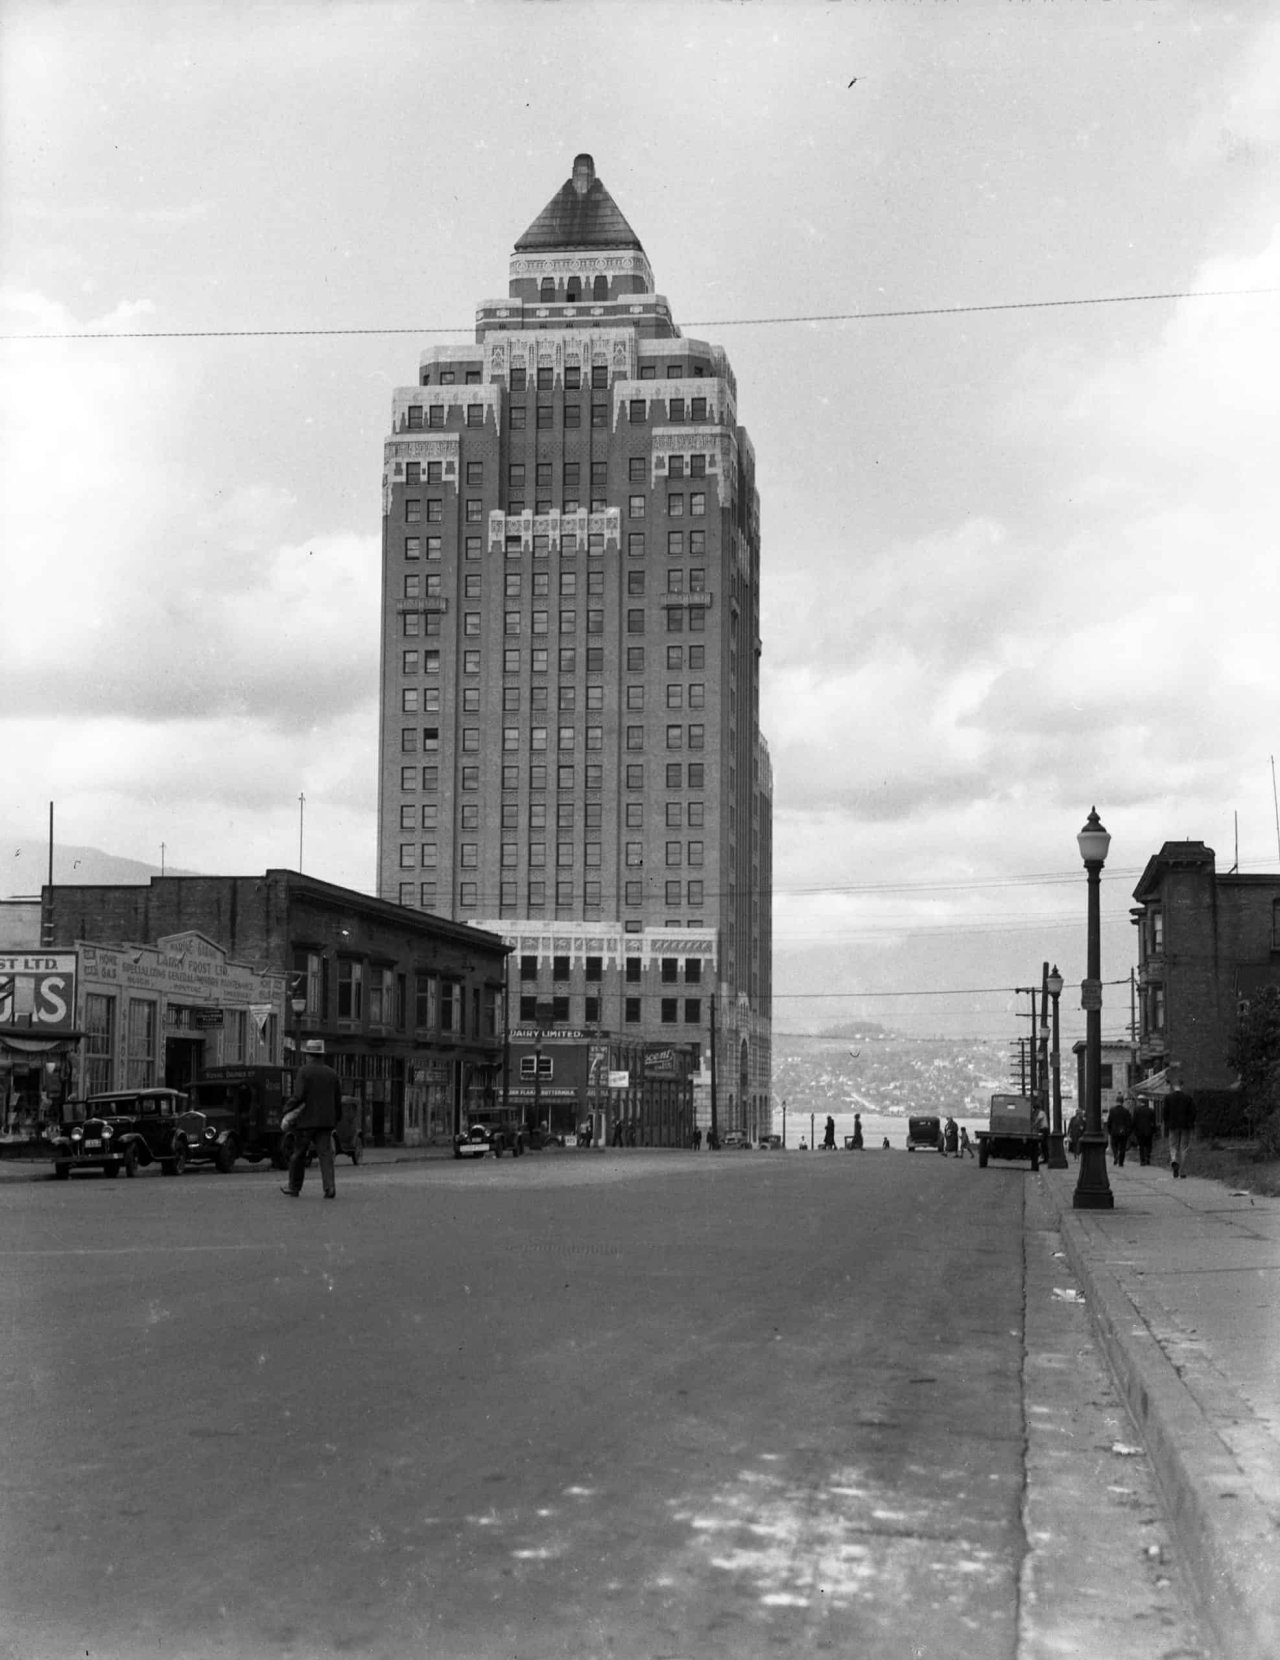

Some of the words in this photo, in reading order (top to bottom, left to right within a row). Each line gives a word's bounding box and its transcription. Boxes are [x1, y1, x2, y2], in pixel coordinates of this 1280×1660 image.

[24, 958, 58, 970] LTD.
[188, 960, 211, 975] FROST
[101, 967, 117, 979] GAS
[541, 1030, 584, 1038] LIMITED.
